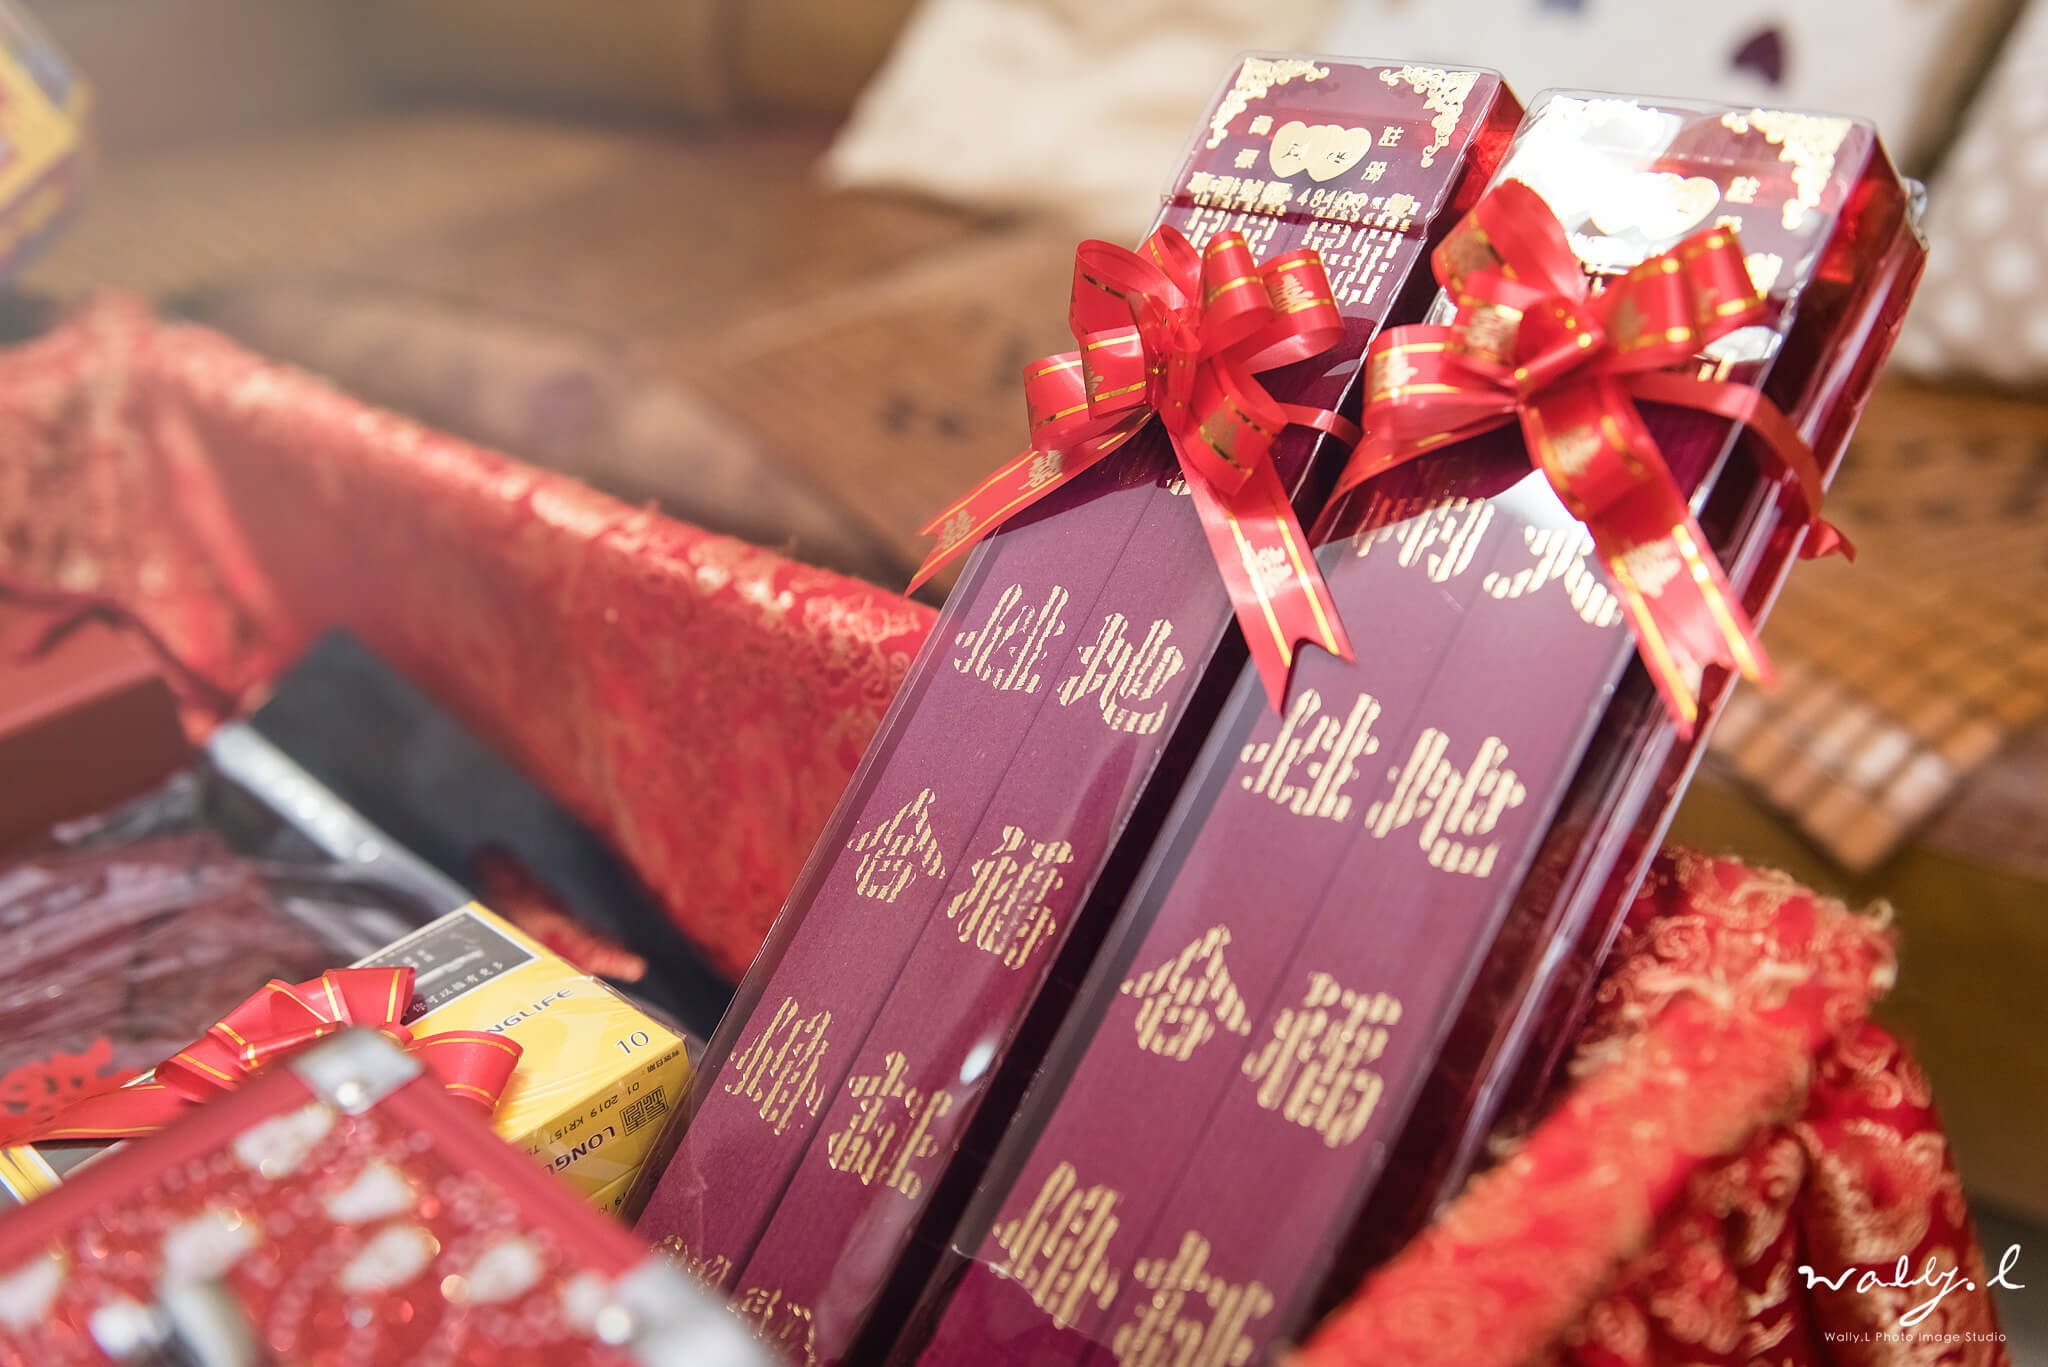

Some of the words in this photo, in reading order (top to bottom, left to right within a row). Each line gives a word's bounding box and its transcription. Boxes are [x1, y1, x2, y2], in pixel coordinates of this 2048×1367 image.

[487, 988, 575, 1033] NGLIFE
[616, 1031, 649, 1055] 10
[590, 1094, 618, 1118] 2019
[544, 1126, 616, 1176] LONGL
